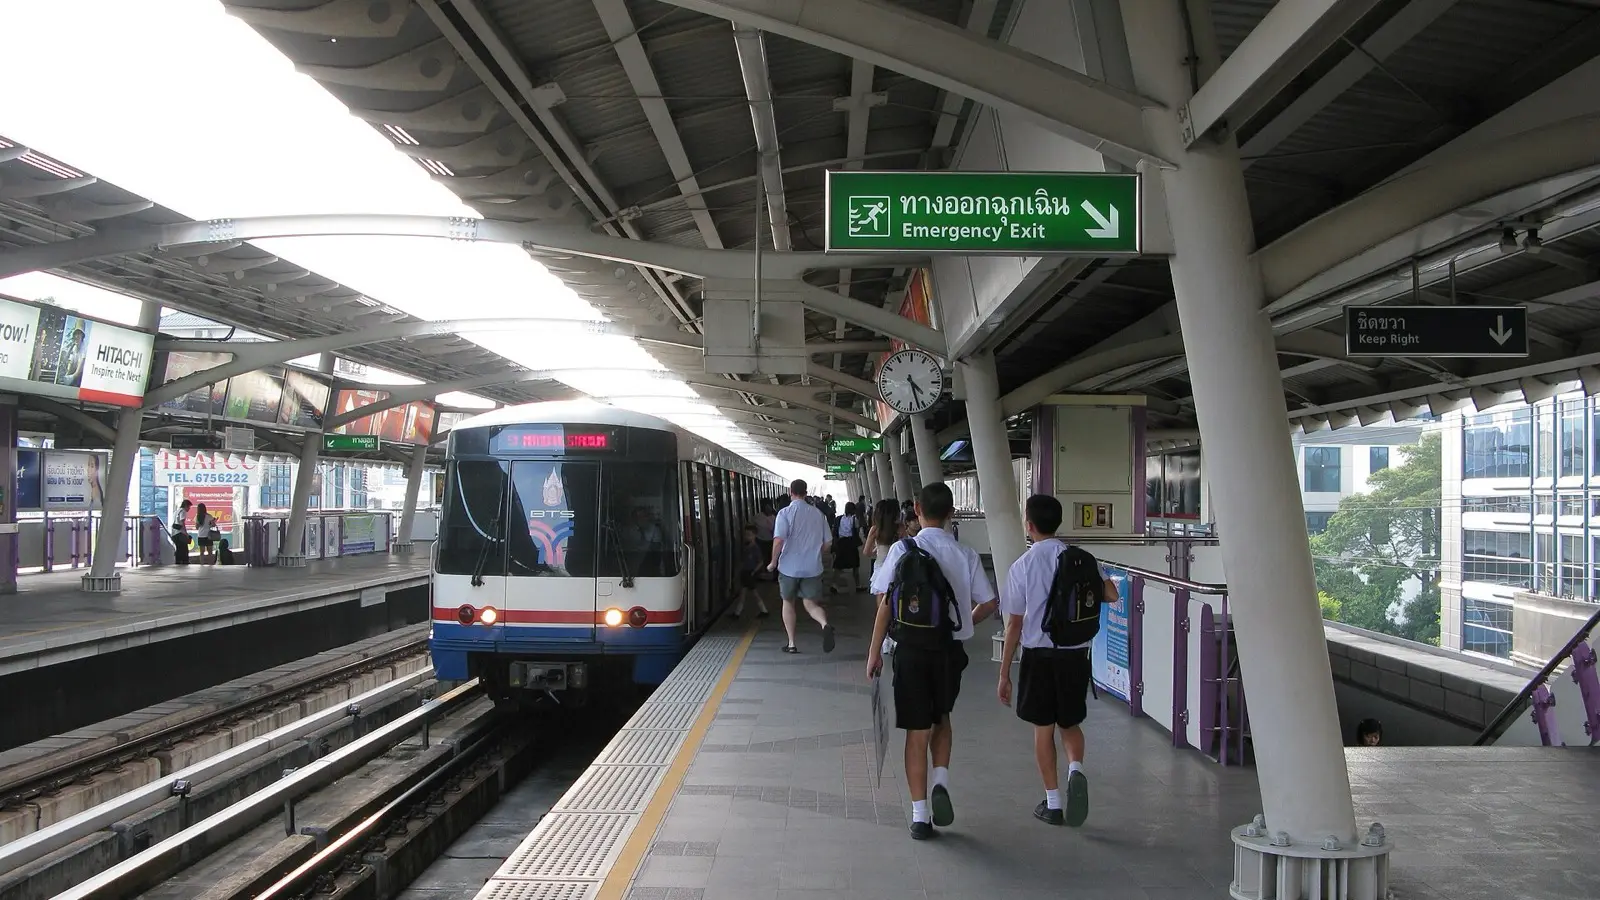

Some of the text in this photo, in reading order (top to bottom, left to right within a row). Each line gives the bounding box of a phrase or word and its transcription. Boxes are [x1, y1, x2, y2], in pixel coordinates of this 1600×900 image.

[900, 188, 1070, 226] ทางออกฉุกเฉิน
[902, 223, 1045, 241] Emergency Exit
[1357, 312, 1405, 330] ชิดขวา
[1359, 334, 1420, 346] Keep Right
[97, 344, 143, 368] HITACHI
[91, 364, 142, 382] Inspire the Next
[167, 473, 248, 483] TEL. 6756222
[530, 510, 575, 518] BTS
